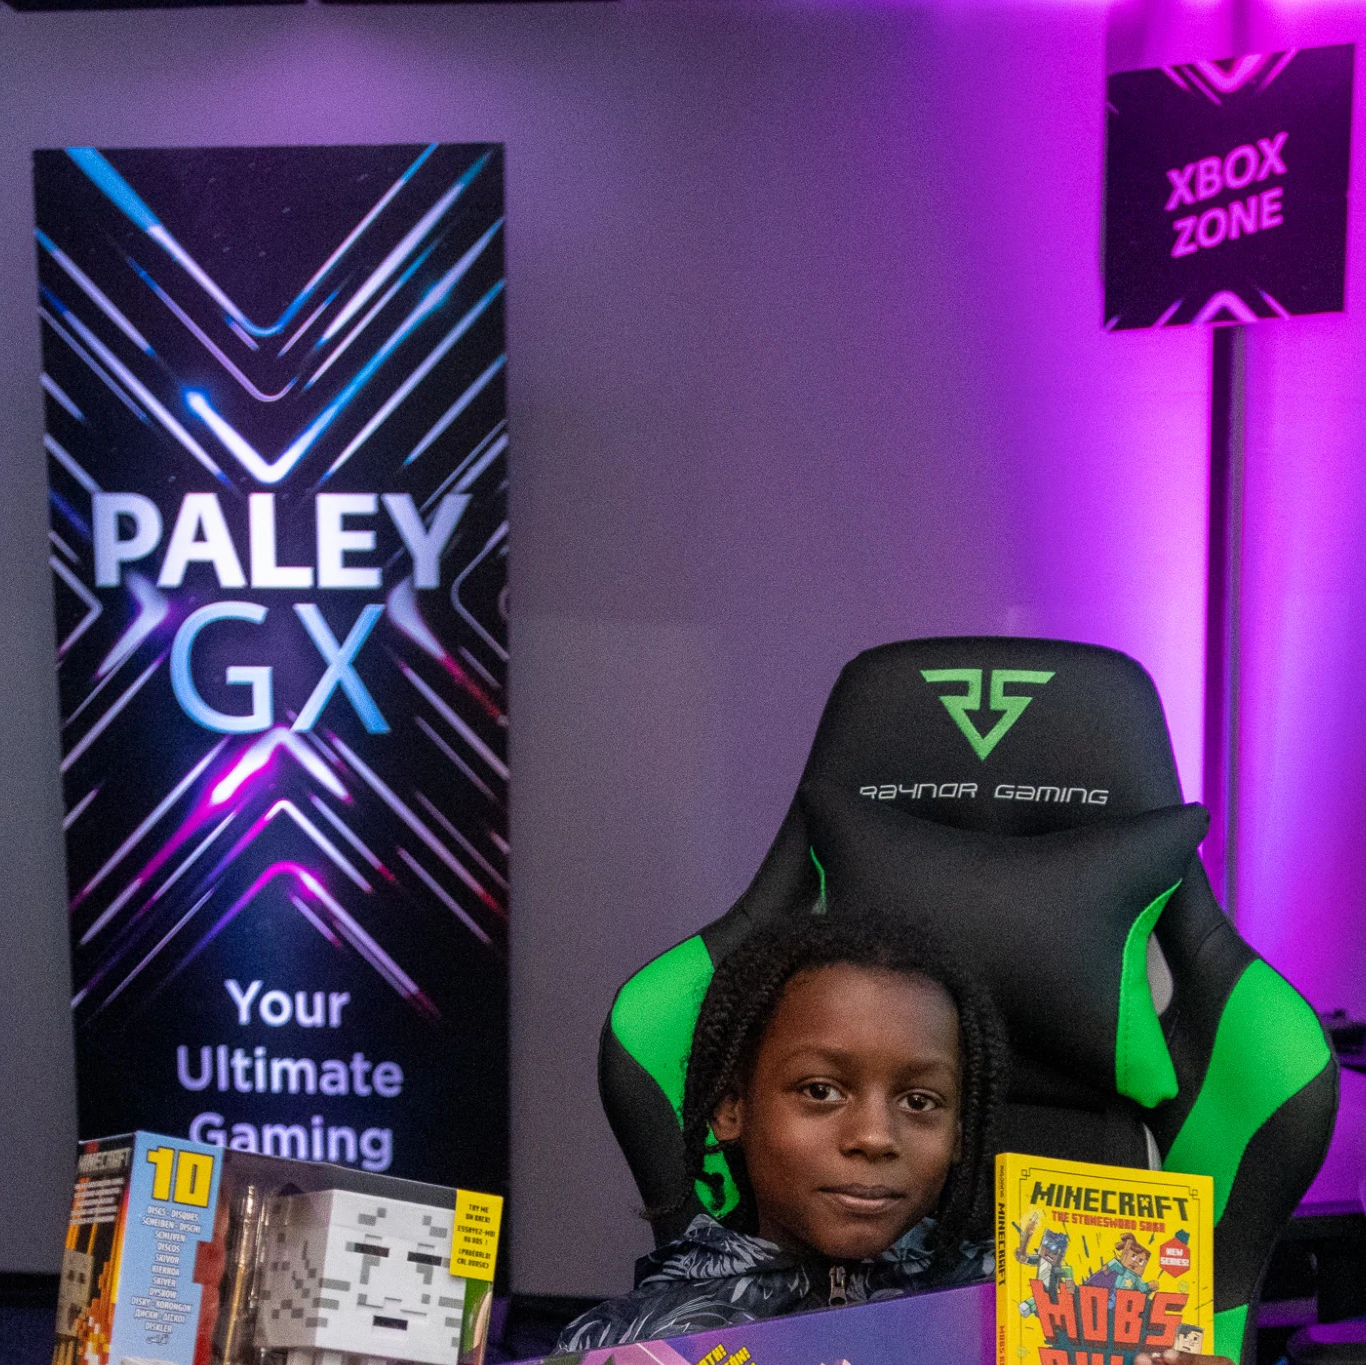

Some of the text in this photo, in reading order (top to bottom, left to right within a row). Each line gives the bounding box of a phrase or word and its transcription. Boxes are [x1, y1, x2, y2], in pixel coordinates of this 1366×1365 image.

[1165, 132, 1289, 211] XBOX
[1171, 187, 1284, 258] ZONE
[91, 491, 473, 589] PALEY
[170, 600, 391, 735] GX
[223, 978, 352, 1028] Your
[176, 1044, 405, 1098] Ultimate
[189, 1111, 394, 1172] Gaming
[146, 1145, 215, 1209] 10
[142, 1216, 175, 1229] SCHEIBEN
[171, 1209, 199, 1221] DISQUES
[475, 1214, 491, 1223] BACK!
[1030, 1181, 1189, 1222] MINECRAFT
[1051, 1211, 1166, 1233] THE STONESWORD SAGA
[155, 1253, 180, 1265] SKIVOR
[157, 1242, 180, 1253] DISCOS
[1165, 1247, 1183, 1256] NEW
[152, 1276, 176, 1287] SKIVER
[1029, 1279, 1189, 1348] MOBS
